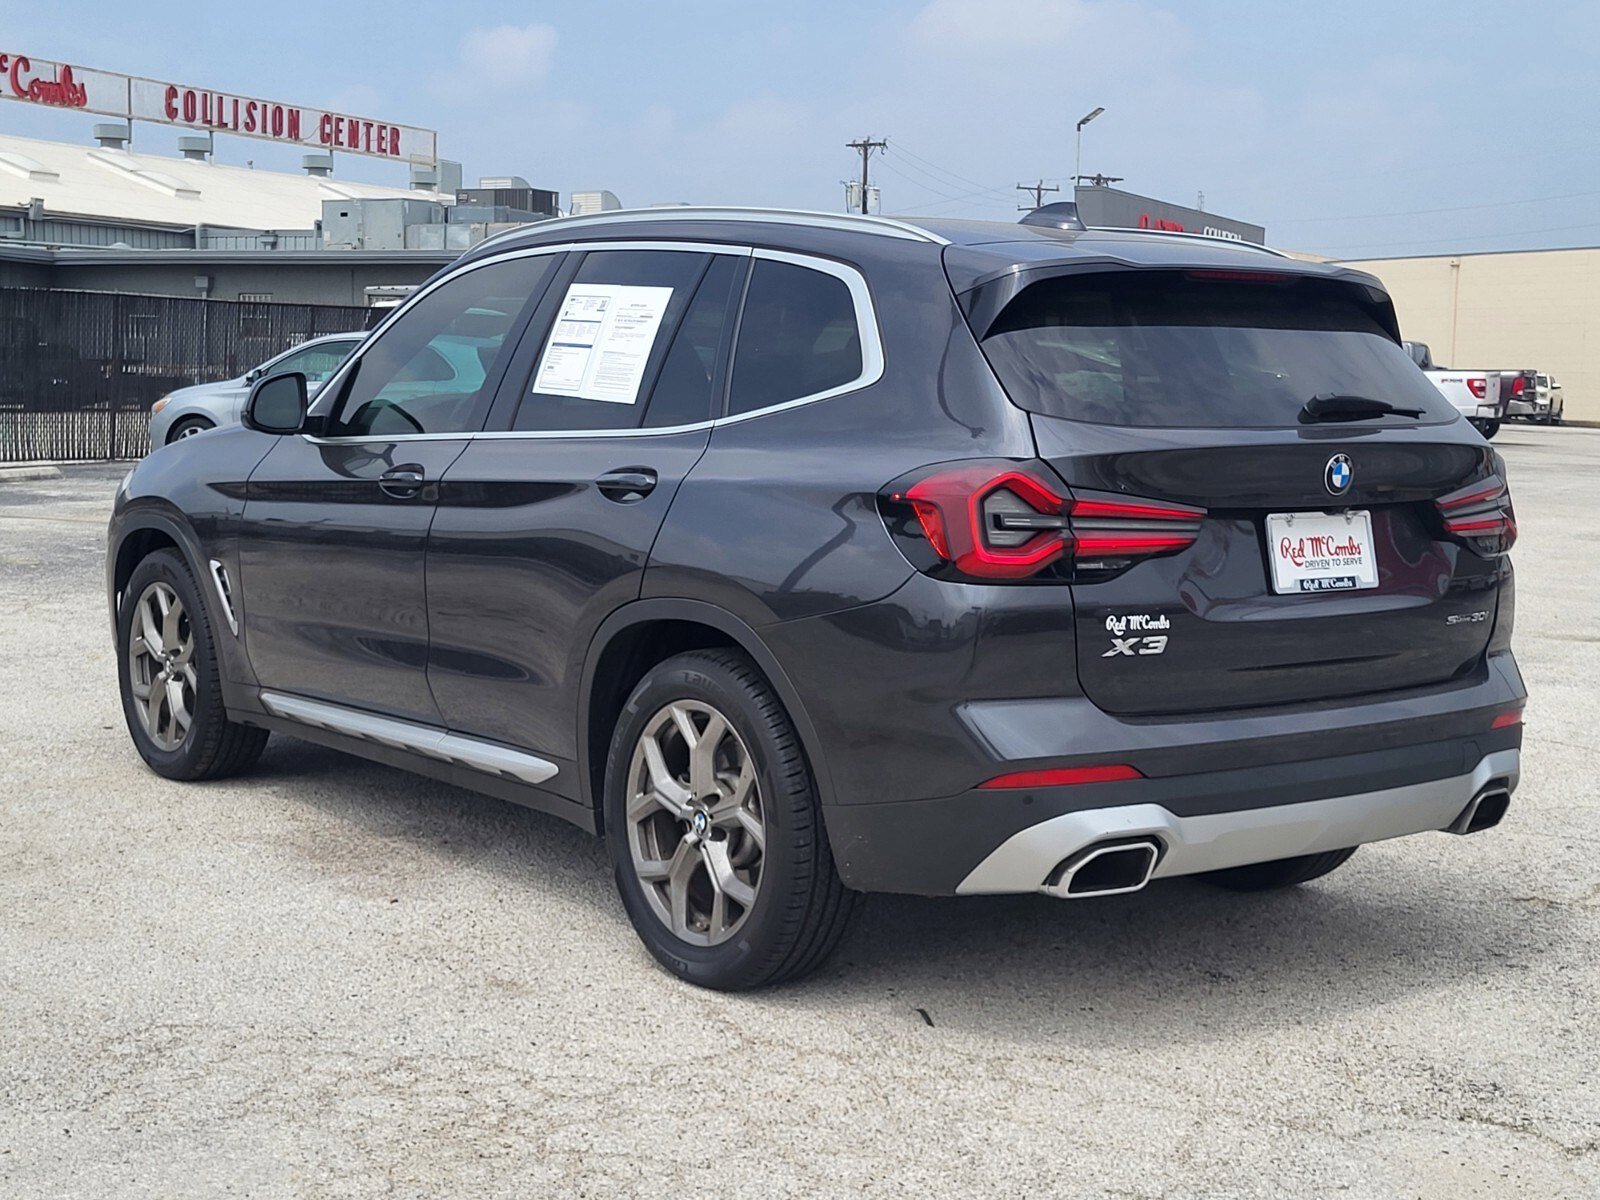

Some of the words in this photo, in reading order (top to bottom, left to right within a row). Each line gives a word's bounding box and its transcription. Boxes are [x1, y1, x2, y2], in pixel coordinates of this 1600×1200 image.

[0, 54, 87, 107] cCombs
[165, 85, 301, 141] COLLISION
[320, 113, 401, 156] CENTER
[1280, 536, 1306, 567] Red
[1304, 559, 1330, 569] DRIVEN
[1331, 558, 1342, 567] TO
[1342, 557, 1363, 566] SERVE
[1105, 614, 1127, 636] Red
[1101, 635, 1169, 657] X3
